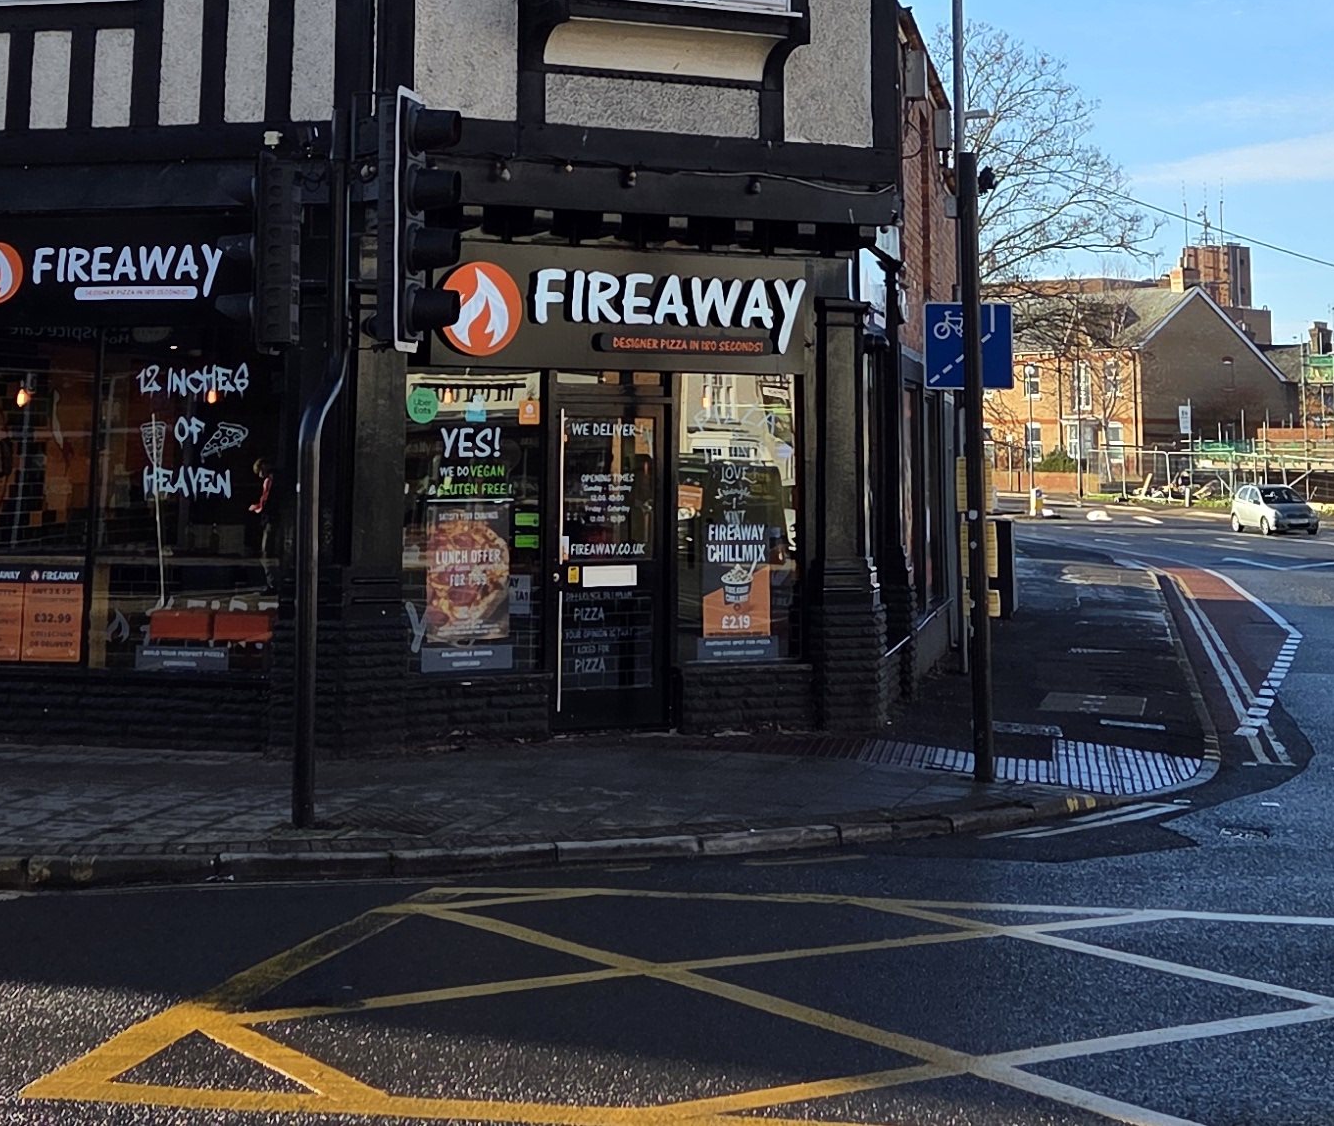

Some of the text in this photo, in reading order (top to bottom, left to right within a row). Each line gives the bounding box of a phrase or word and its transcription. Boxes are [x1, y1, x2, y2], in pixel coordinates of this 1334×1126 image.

[32, 243, 223, 298] FIREAWAY
[534, 267, 807, 355] FIREAWAY
[612, 336, 764, 353] DESIGNER PIZZA IN 180 SECONDS!
[136, 362, 250, 401] 12 INCHES
[413, 398, 431, 407] Uber
[414, 406, 432, 414] Eats
[174, 415, 206, 448] OF
[572, 423, 590, 436] WE
[592, 422, 636, 436] DELIVER
[439, 426, 502, 459] YES!
[439, 465, 505, 478] WE DO VEGAN
[580, 473, 611, 483] OPENING
[721, 462, 757, 484] LOVE
[142, 464, 232, 500] HEAVEN
[437, 483, 478, 497] GLUTEN
[708, 524, 765, 542] FIREAWAY
[435, 549, 502, 565] LUNCH OFFER
[570, 543, 646, 556] FIREAWAY.CO.UK
[707, 544, 766, 563] CHILLMIX
[41, 570, 80, 581] FIREAWAY
[34, 613, 72, 624] £32.99
[573, 606, 605, 622] PIZZA
[574, 657, 606, 674] PIZZA
